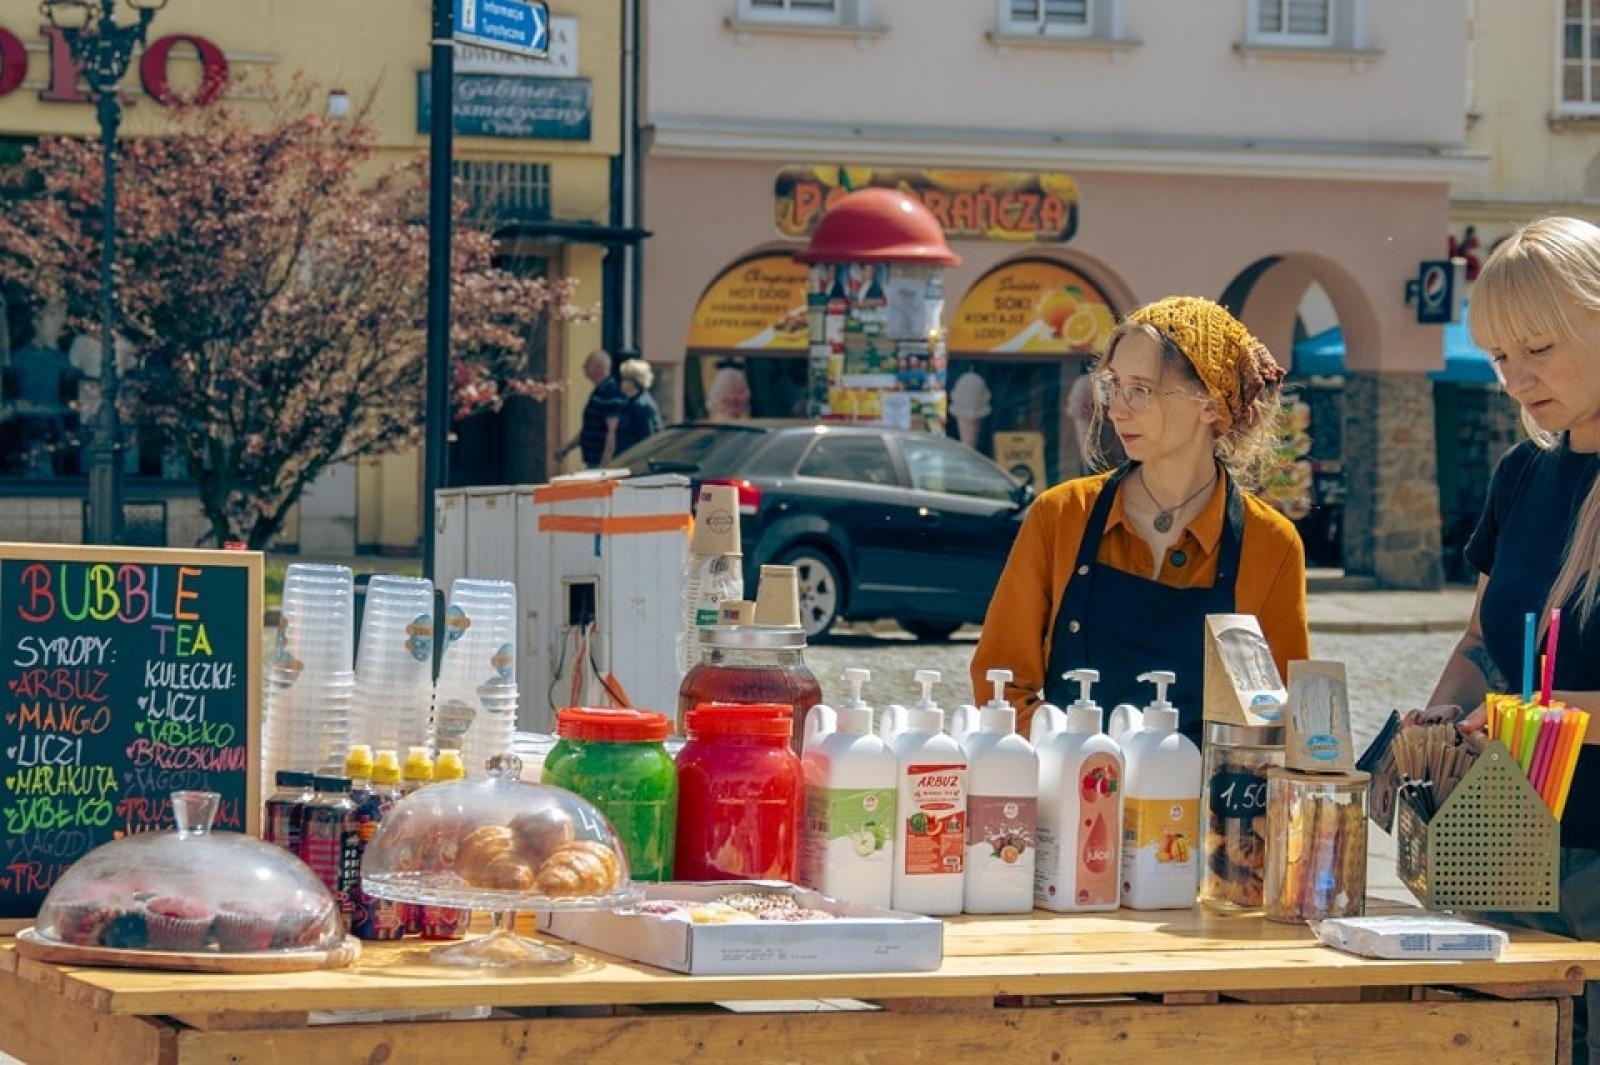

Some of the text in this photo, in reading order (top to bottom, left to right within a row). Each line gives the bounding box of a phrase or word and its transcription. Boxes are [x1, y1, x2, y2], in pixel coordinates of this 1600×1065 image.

[995, 297, 1031, 310] SOKI
[18, 563, 203, 624] BUBBLE
[14, 635, 117, 667] SYROPY:
[151, 624, 213, 656] TEA
[15, 668, 109, 702] ARBUZ
[145, 660, 236, 689] KULECZKI:
[18, 702, 111, 734] MANGO
[147, 689, 206, 722] LICZI
[147, 718, 236, 747] JABŁKO
[16, 734, 82, 766] LICZI
[15, 765, 118, 805] MARAKUJA
[918, 775, 958, 787] ARBUZ
[8, 797, 112, 833] JABŁKO
